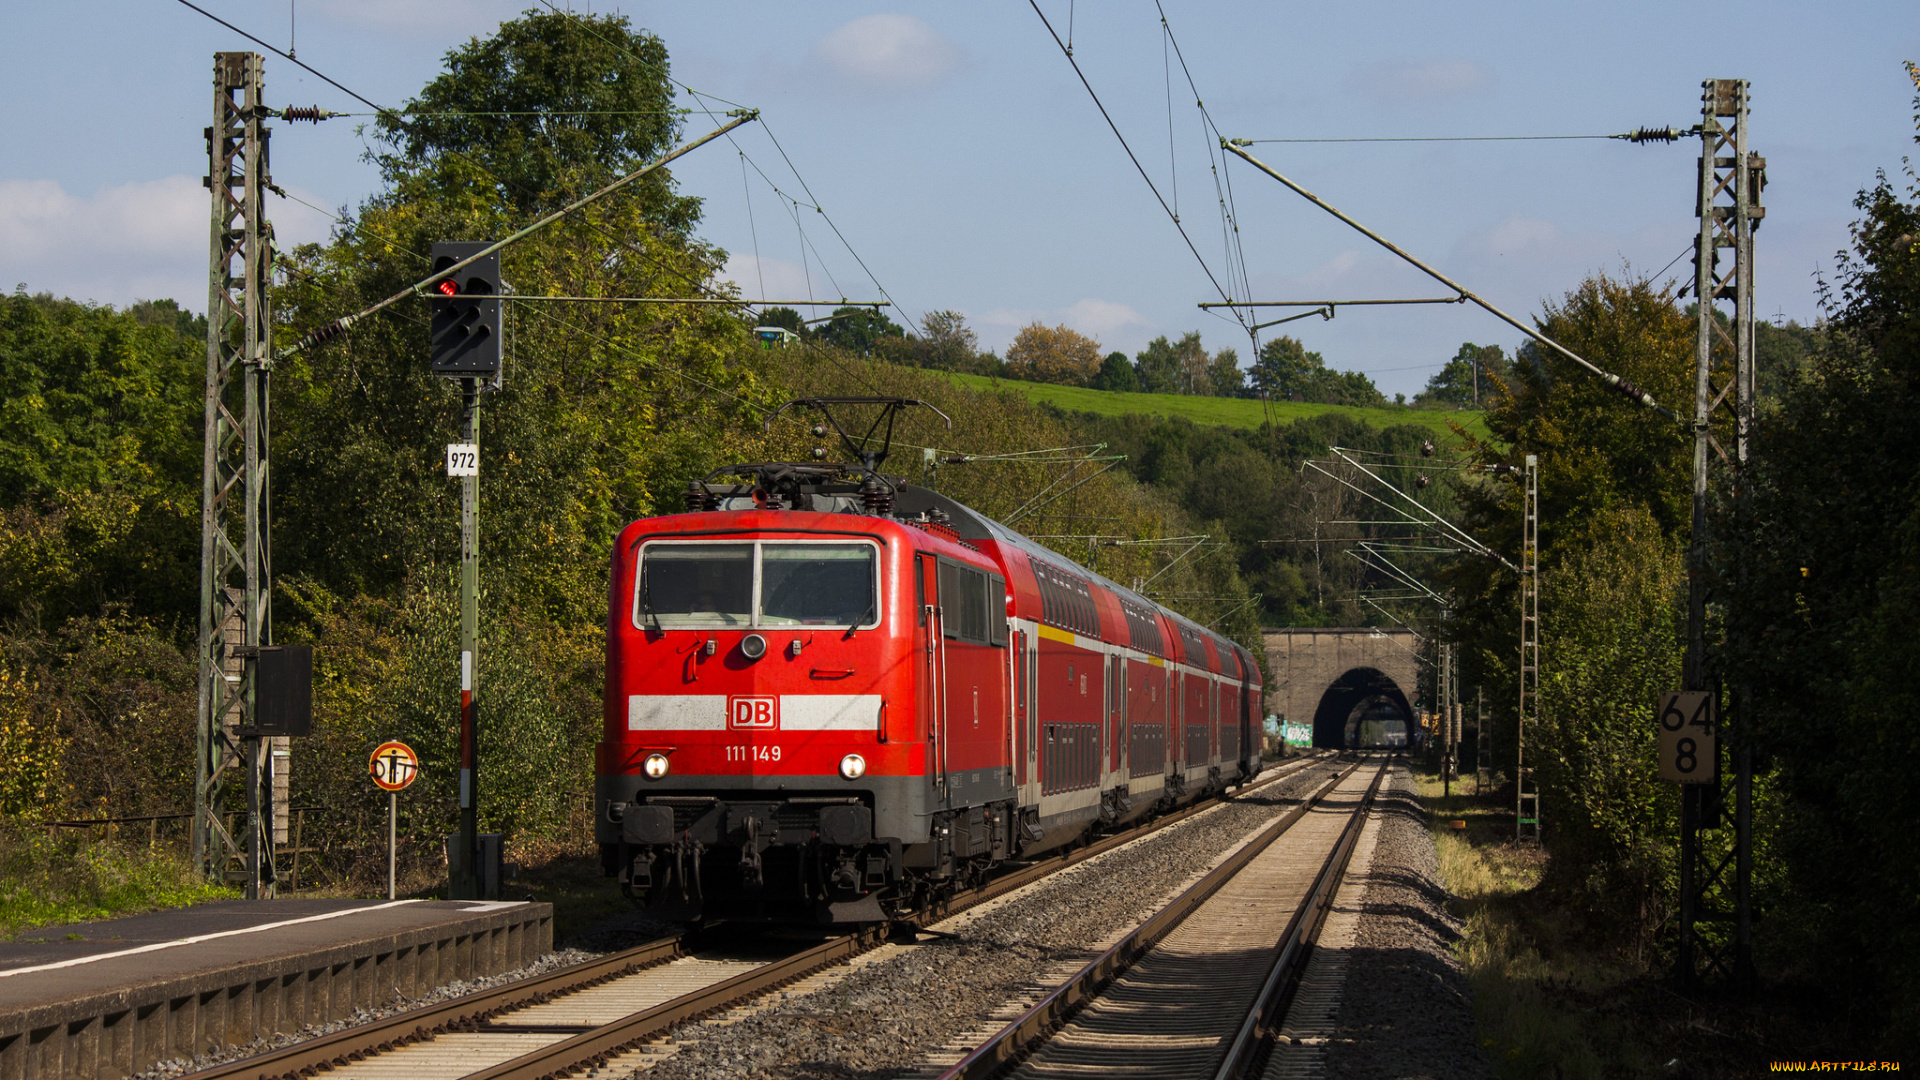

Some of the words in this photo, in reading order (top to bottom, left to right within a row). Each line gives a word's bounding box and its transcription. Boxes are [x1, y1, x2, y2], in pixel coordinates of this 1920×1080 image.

[451, 453, 475, 468] 972
[736, 701, 771, 724] DB
[1661, 695, 1714, 736] 64
[725, 745, 745, 762] 111
[752, 745, 781, 762] 149
[1675, 737, 1697, 773] 8
